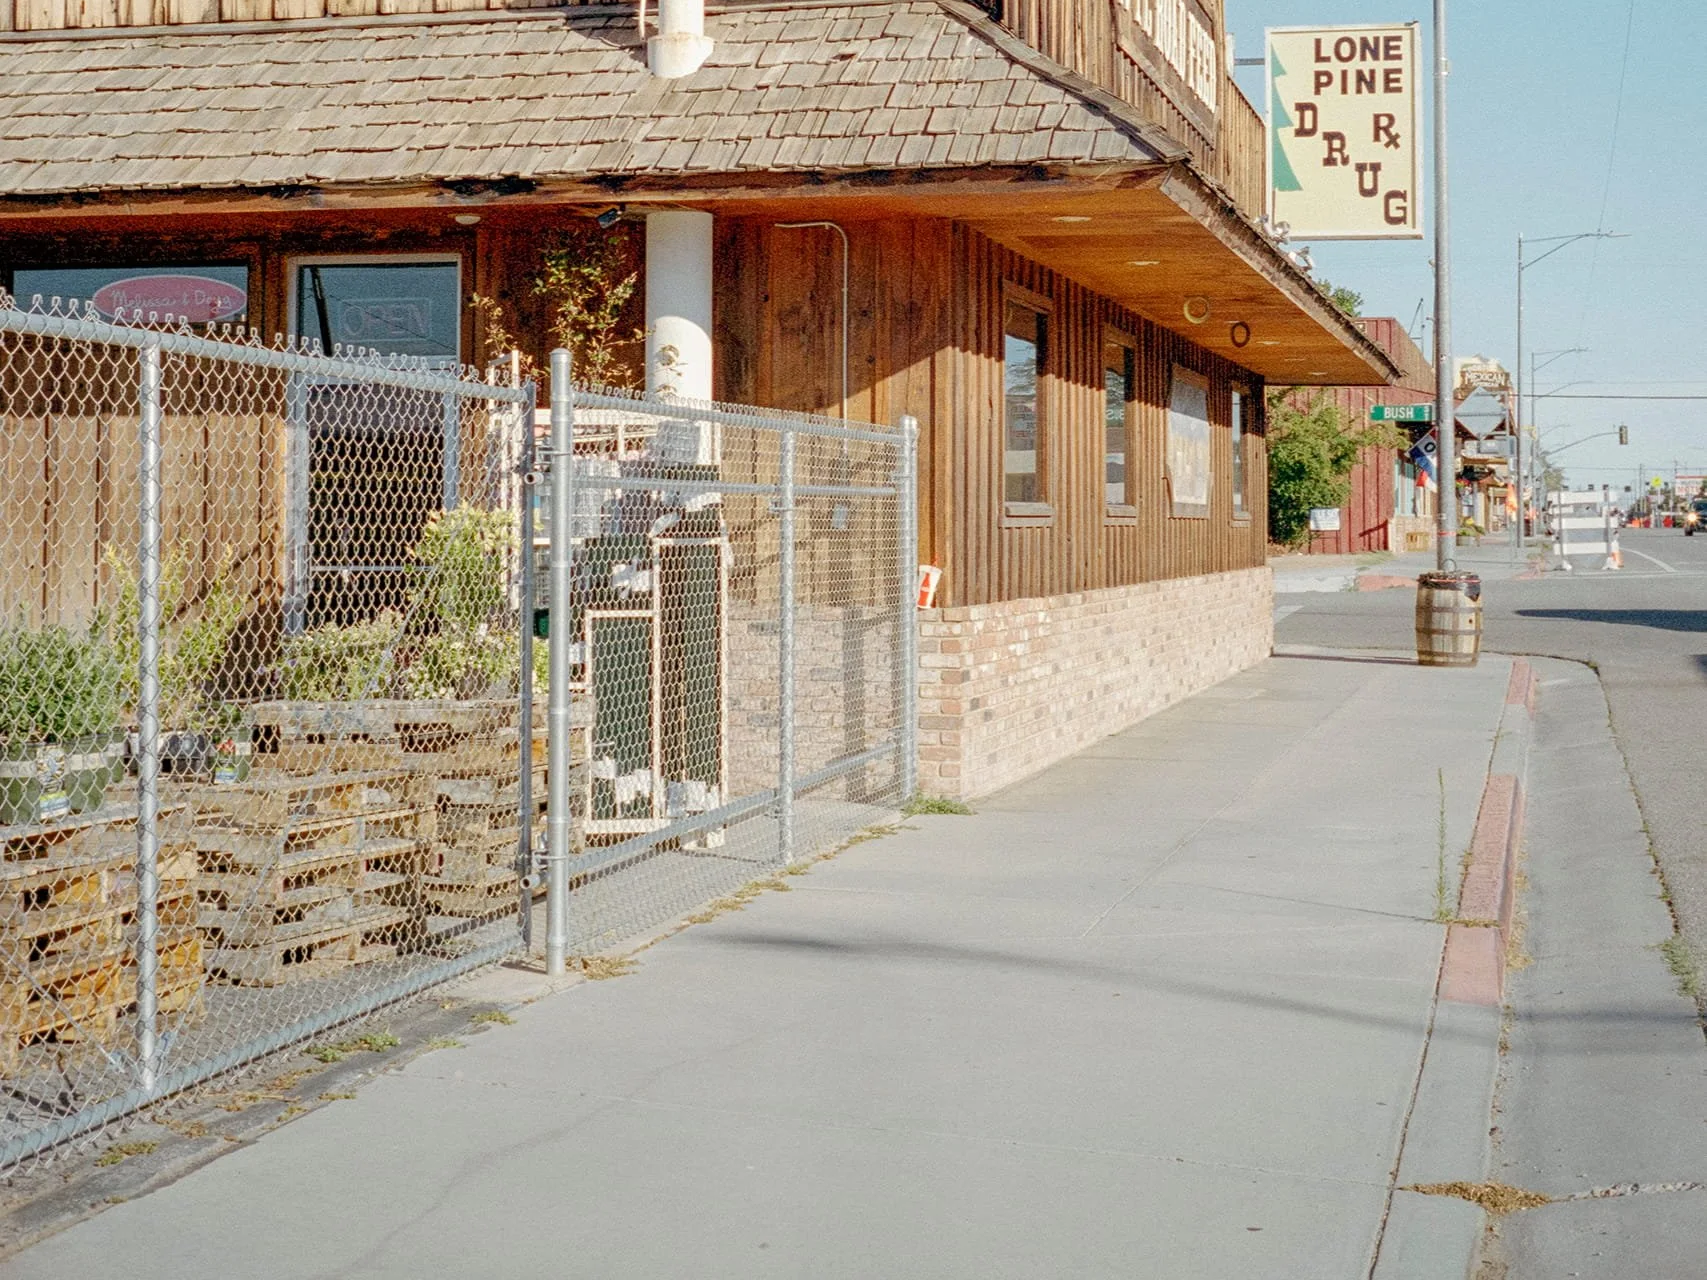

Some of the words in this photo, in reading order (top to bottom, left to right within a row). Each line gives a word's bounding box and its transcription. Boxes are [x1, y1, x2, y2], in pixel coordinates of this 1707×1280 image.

[1314, 35, 1404, 64] LONE
[1314, 67, 1404, 96] PINE
[1294, 102, 1408, 226] DRUG
[1384, 406, 1414, 419] BUSH
